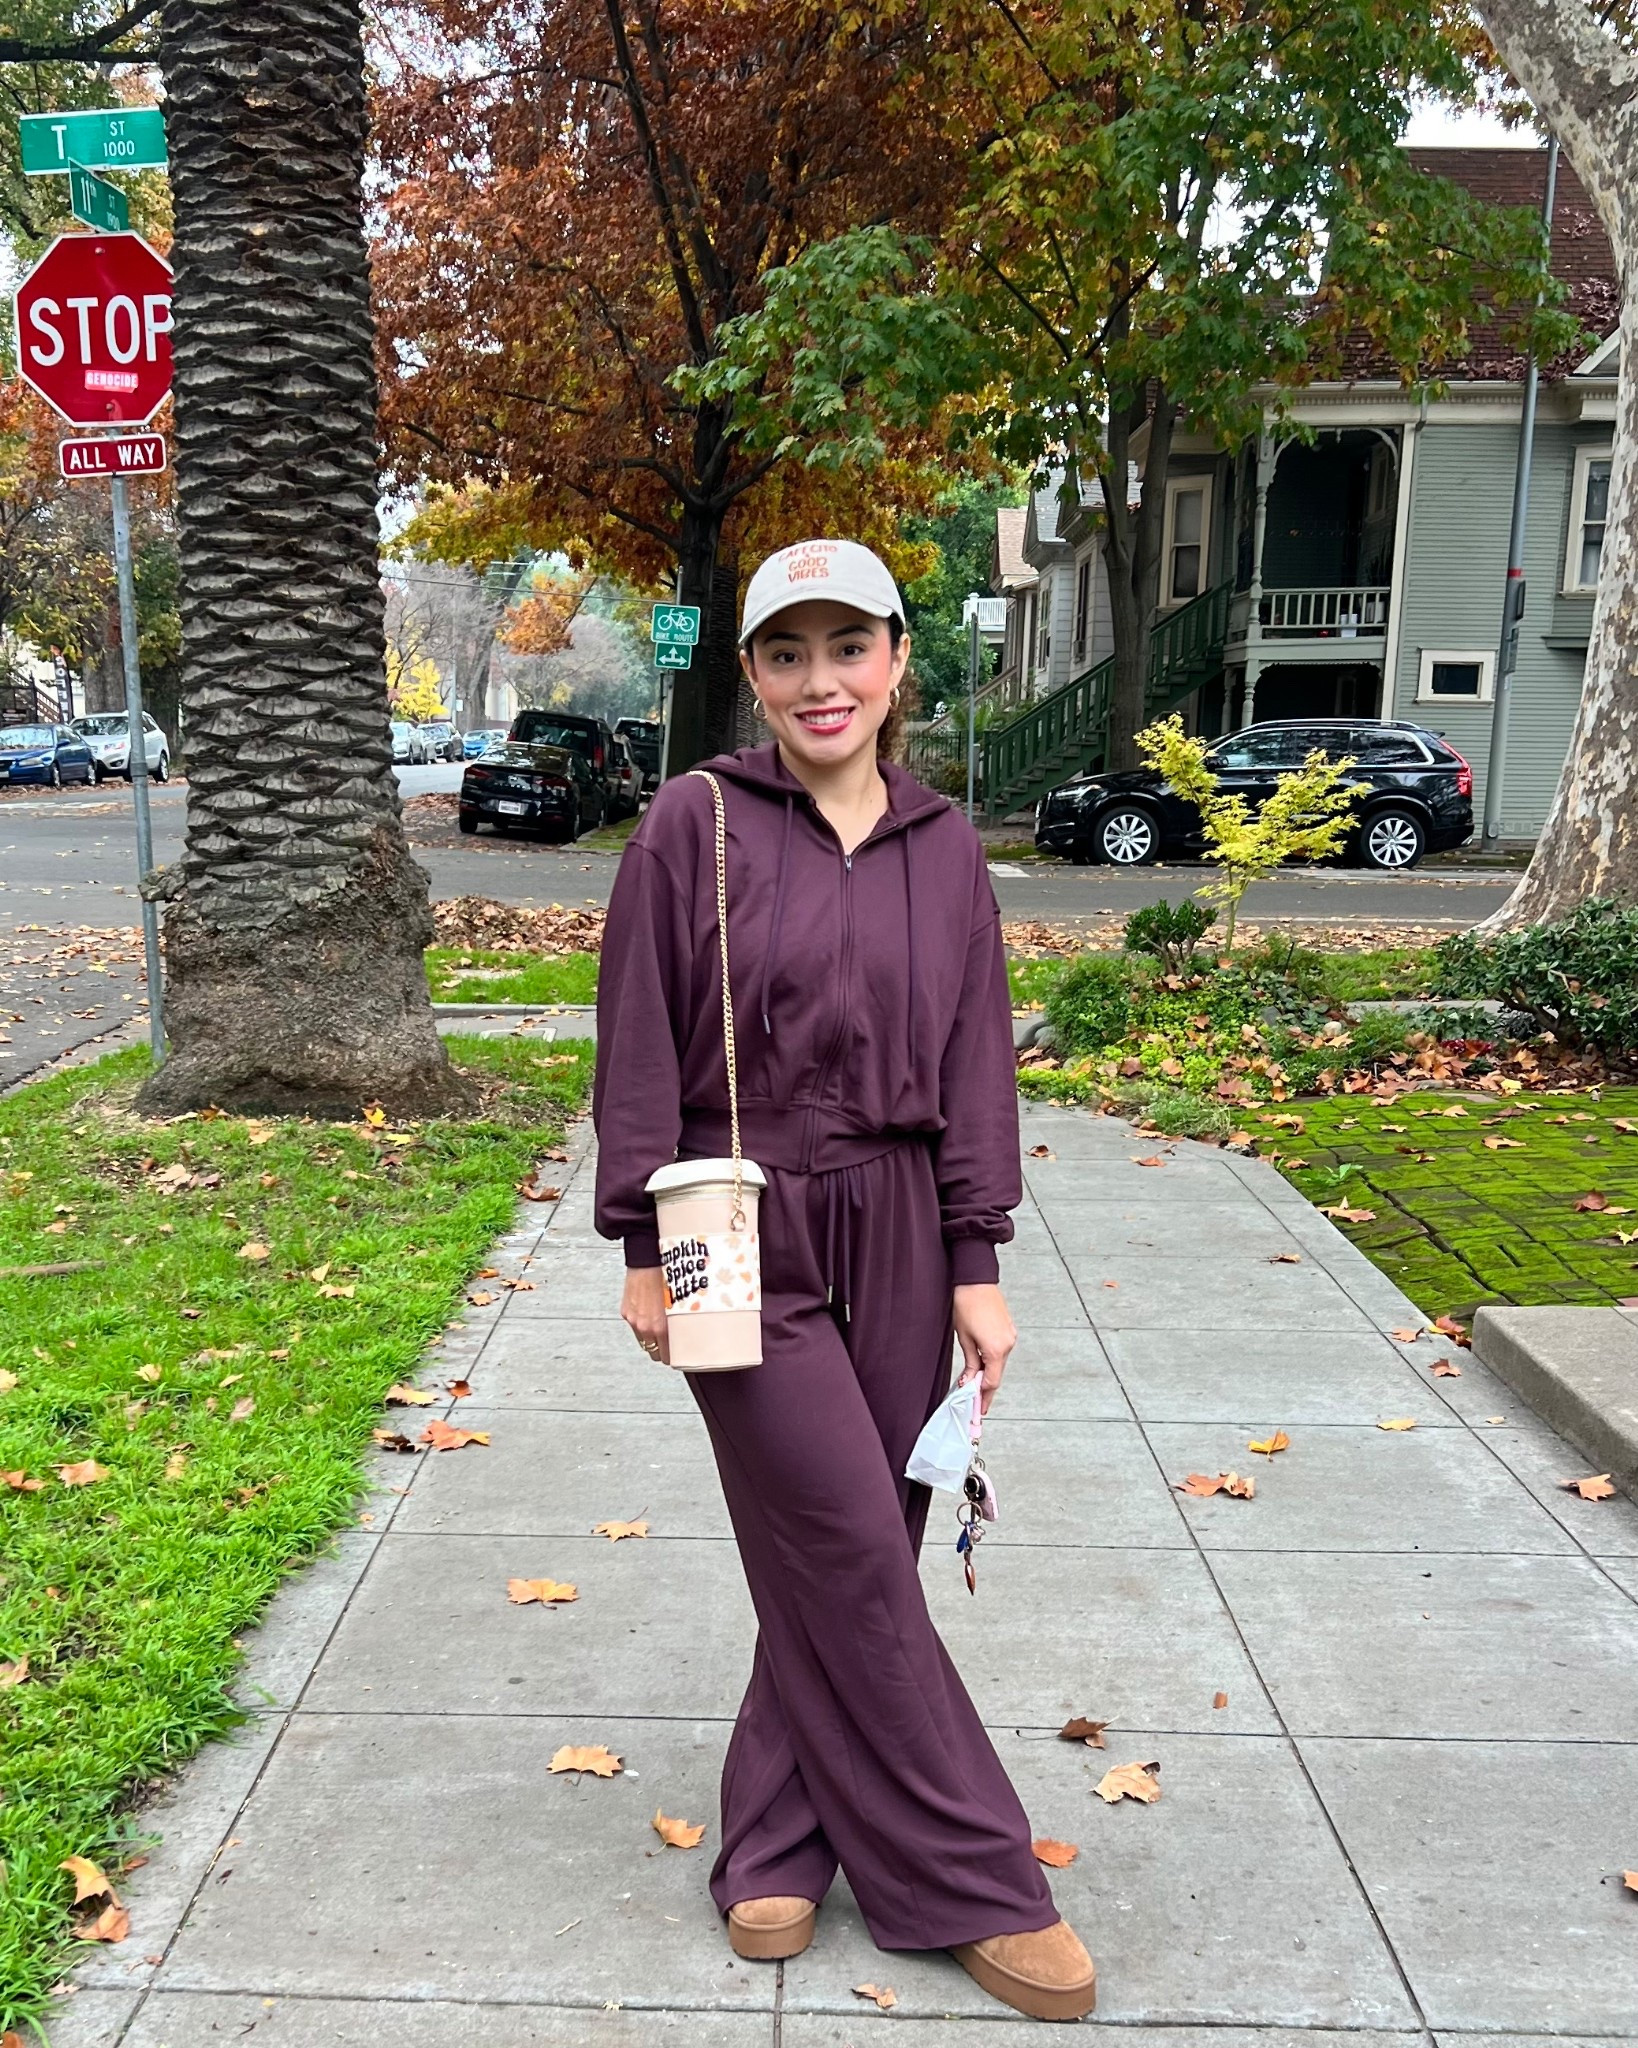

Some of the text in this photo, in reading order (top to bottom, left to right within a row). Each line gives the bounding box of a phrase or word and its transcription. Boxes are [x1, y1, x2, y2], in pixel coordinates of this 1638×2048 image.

[51, 120, 125, 160] T ST
[103, 139, 135, 157] 1000
[29, 293, 175, 367] STOP
[86, 372, 138, 388] GENOCIDE
[69, 442, 156, 470] ALL WAY
[789, 556, 828, 572] GOOD
[788, 567, 830, 583] VIBES
[655, 632, 694, 643] BIKE ROUTE
[666, 1258, 706, 1286] Spice
